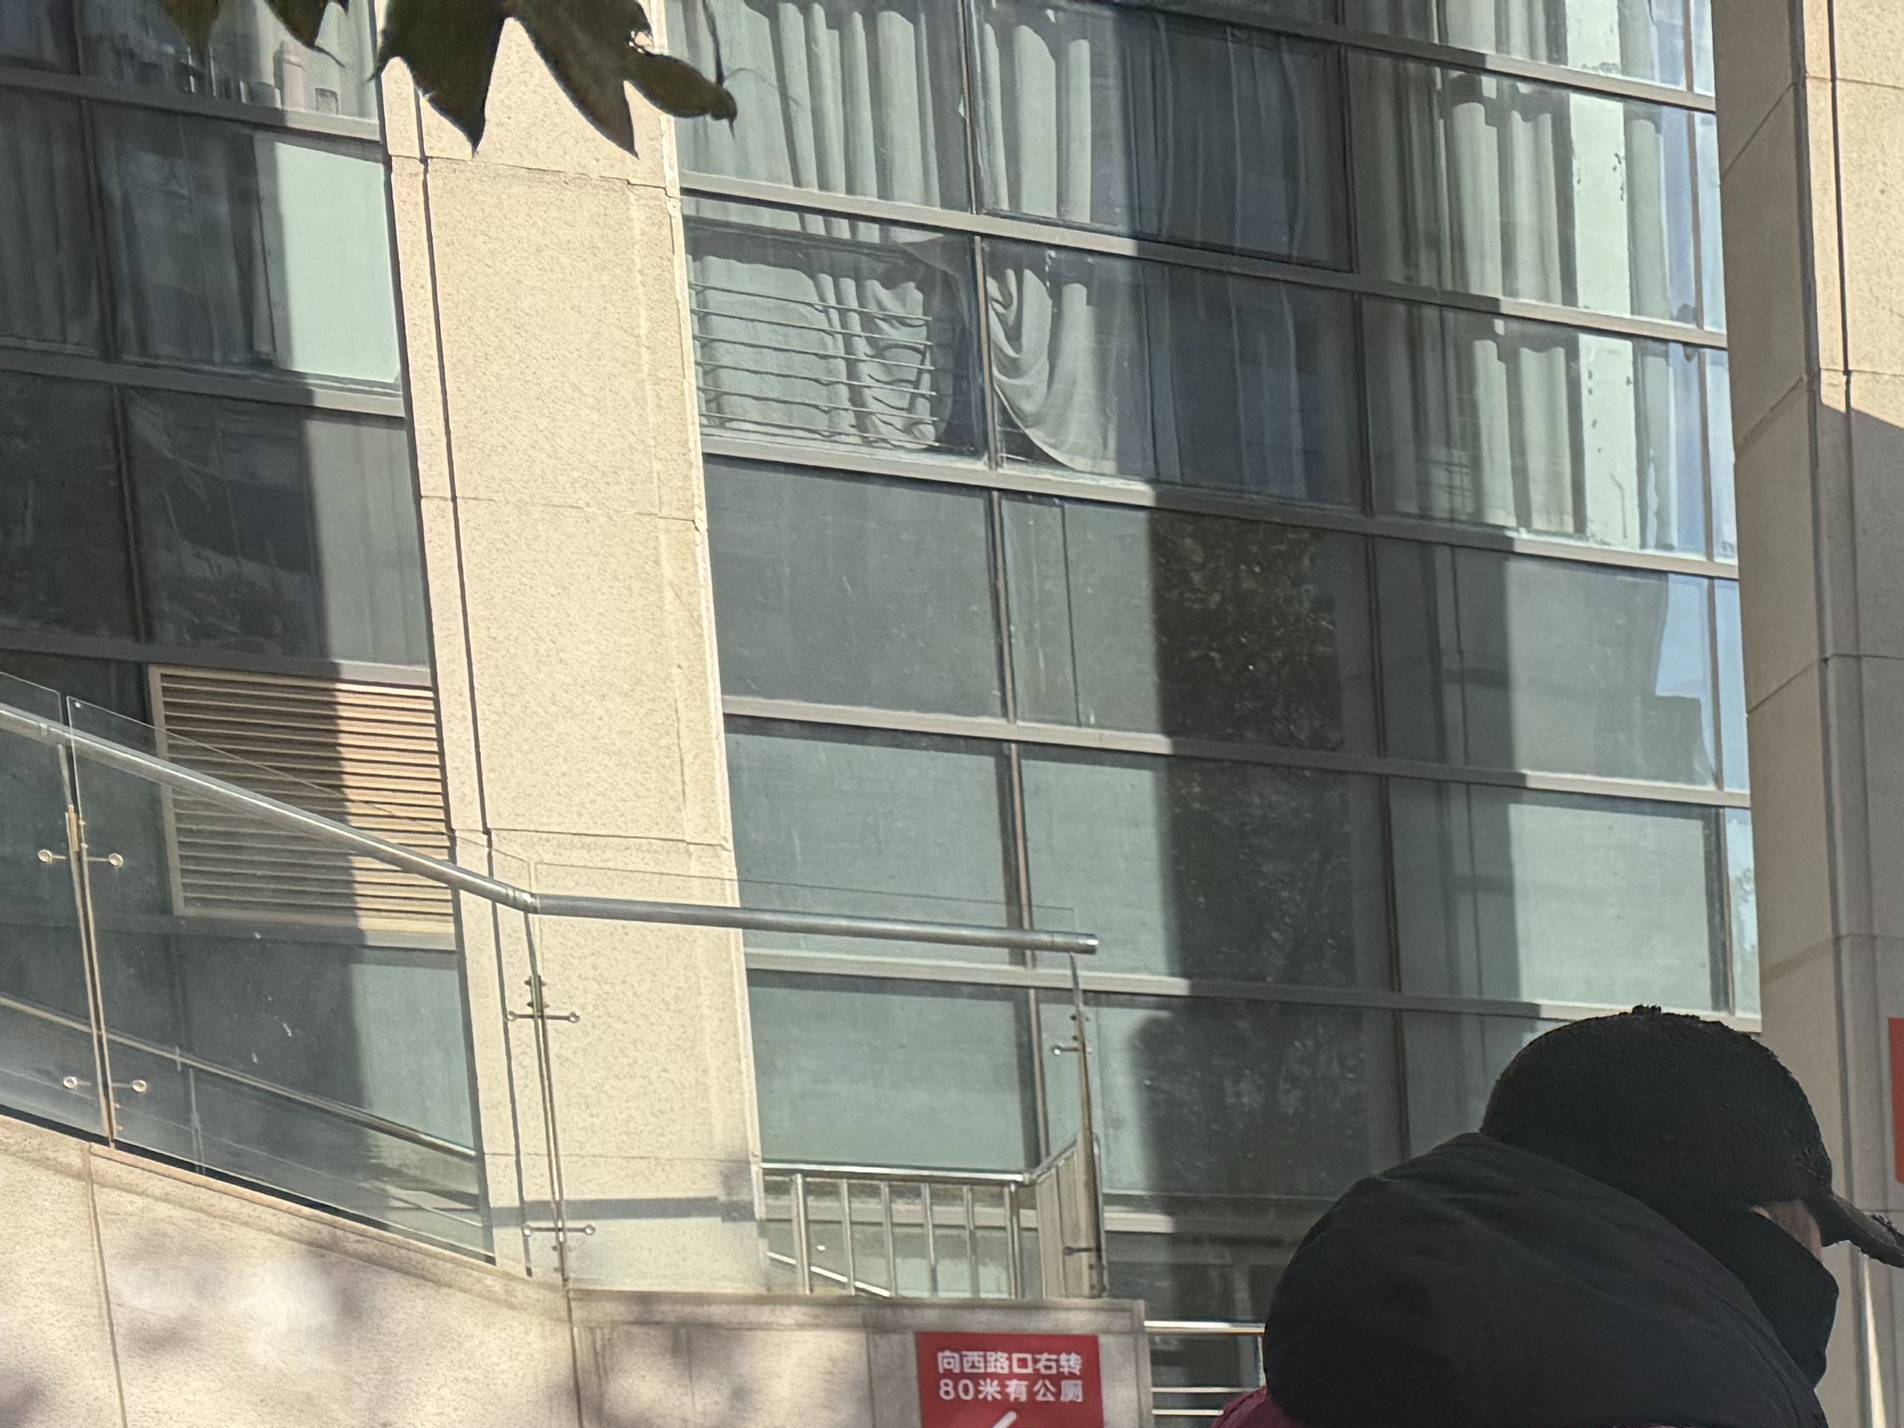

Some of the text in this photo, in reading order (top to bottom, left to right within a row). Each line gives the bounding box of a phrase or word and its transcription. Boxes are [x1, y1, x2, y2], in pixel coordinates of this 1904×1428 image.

[937, 1350, 1083, 1376] 向西路口右转
[939, 1379, 1083, 1403] 80米有公厕
